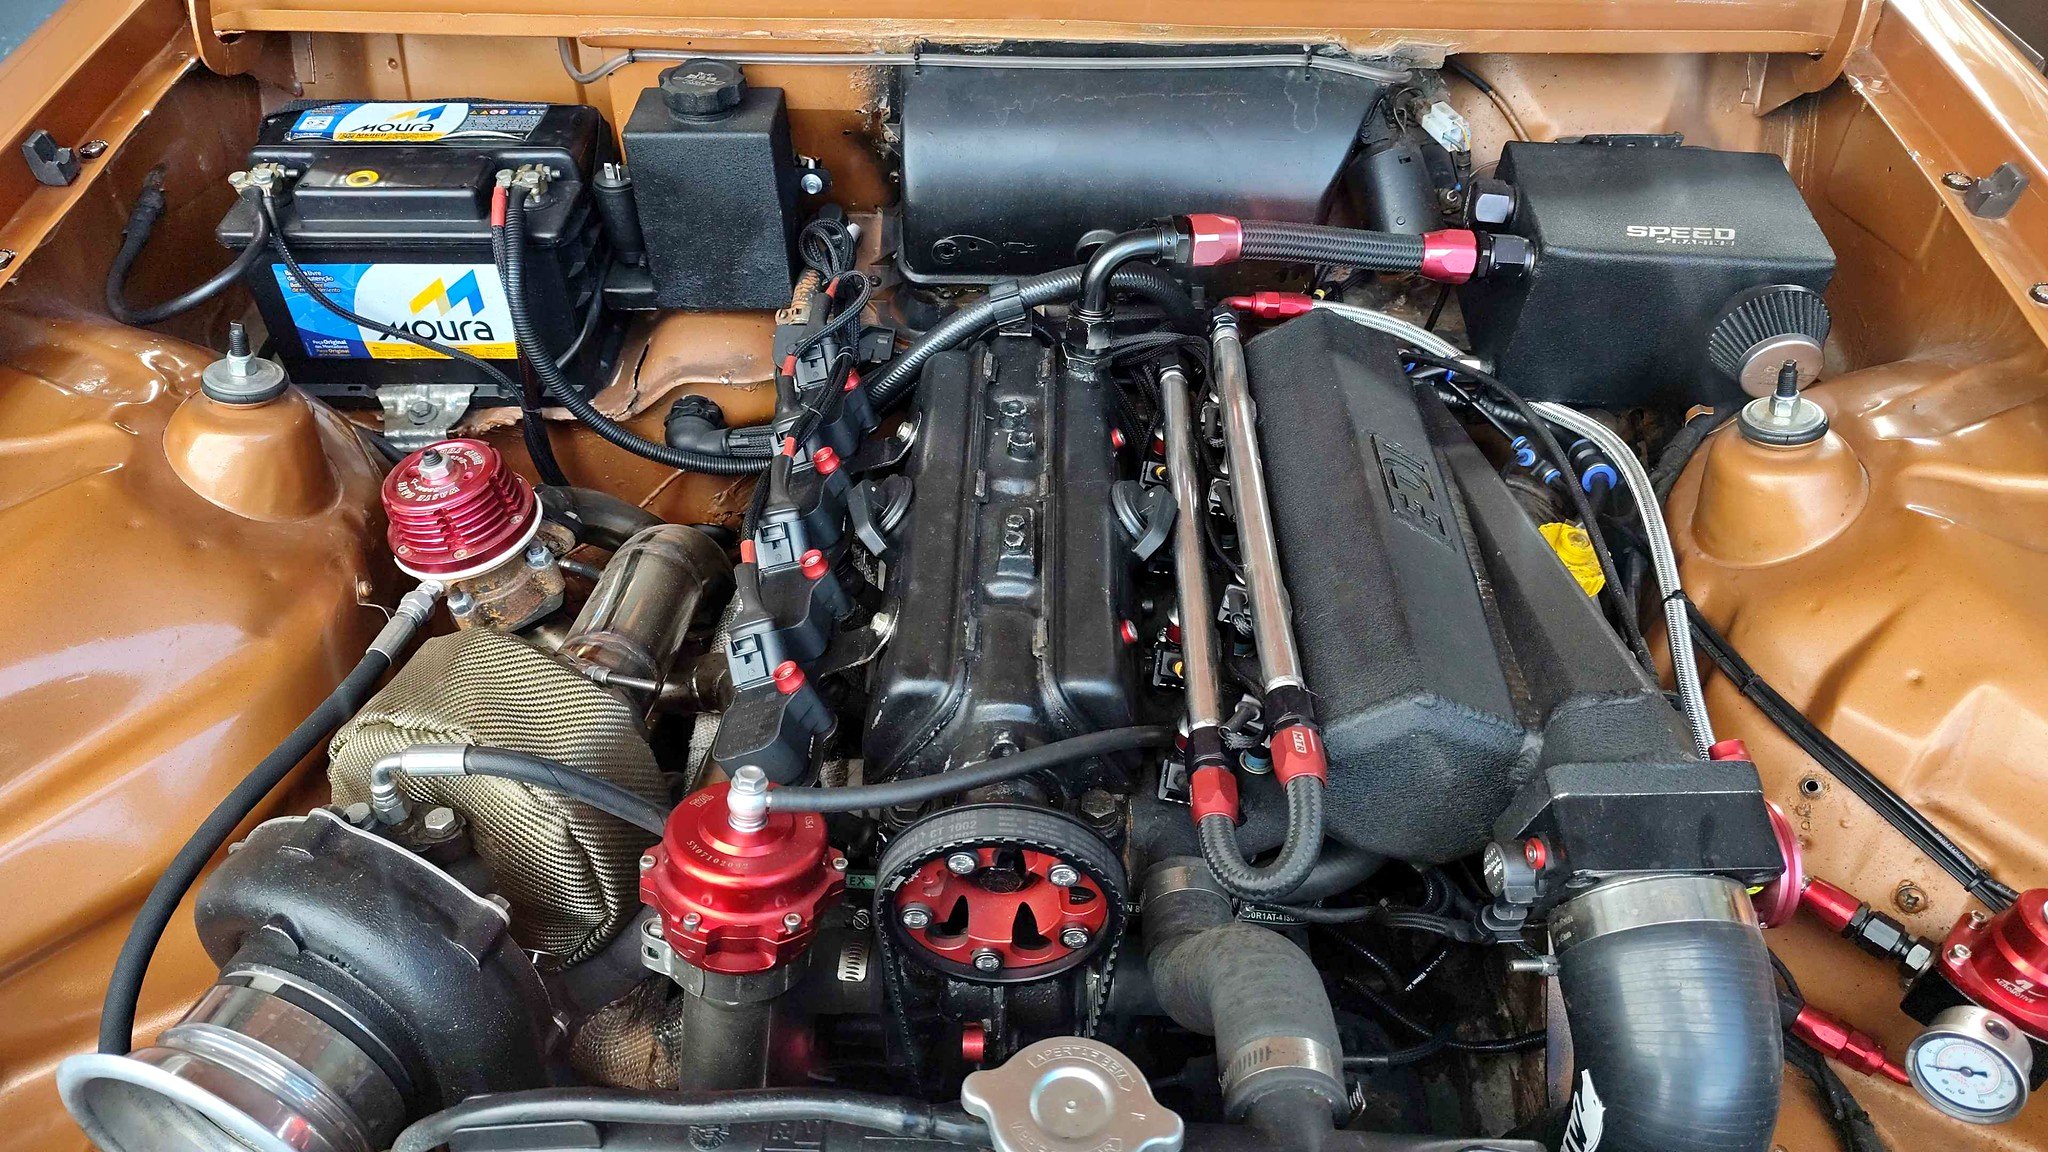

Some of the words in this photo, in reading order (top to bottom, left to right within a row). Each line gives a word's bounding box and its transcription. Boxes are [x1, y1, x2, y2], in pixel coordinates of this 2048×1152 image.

[1626, 225, 1736, 240] SPEED
[1293, 732, 1305, 753] MTR
[949, 820, 978, 833] 1002
[849, 876, 866, 886] EX
